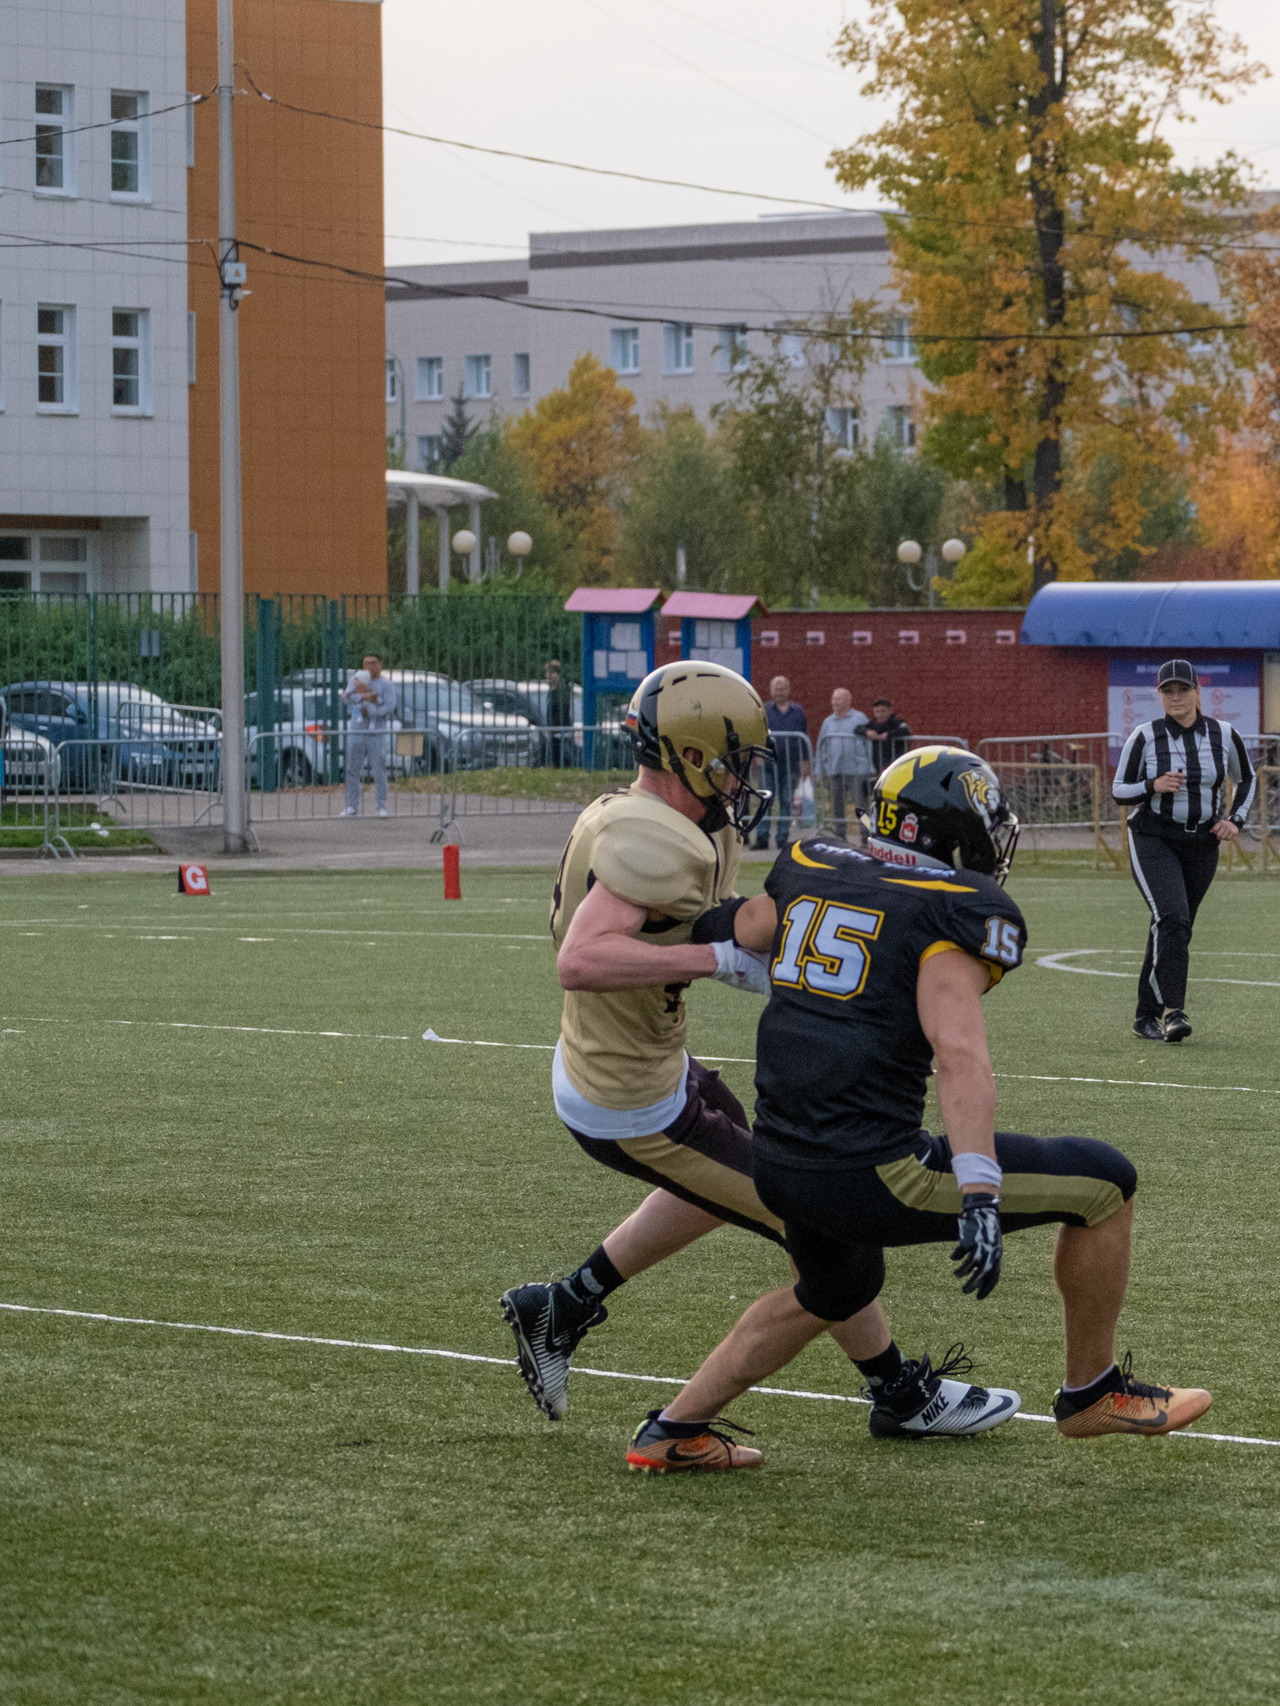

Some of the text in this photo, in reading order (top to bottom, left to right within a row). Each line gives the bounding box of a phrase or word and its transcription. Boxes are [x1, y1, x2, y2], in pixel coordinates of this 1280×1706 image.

[877, 801, 899, 830] 15
[185, 865, 208, 890] G
[771, 894, 885, 1000] 15
[980, 915, 1021, 967] 15
[921, 1391, 950, 1427] NIKE
